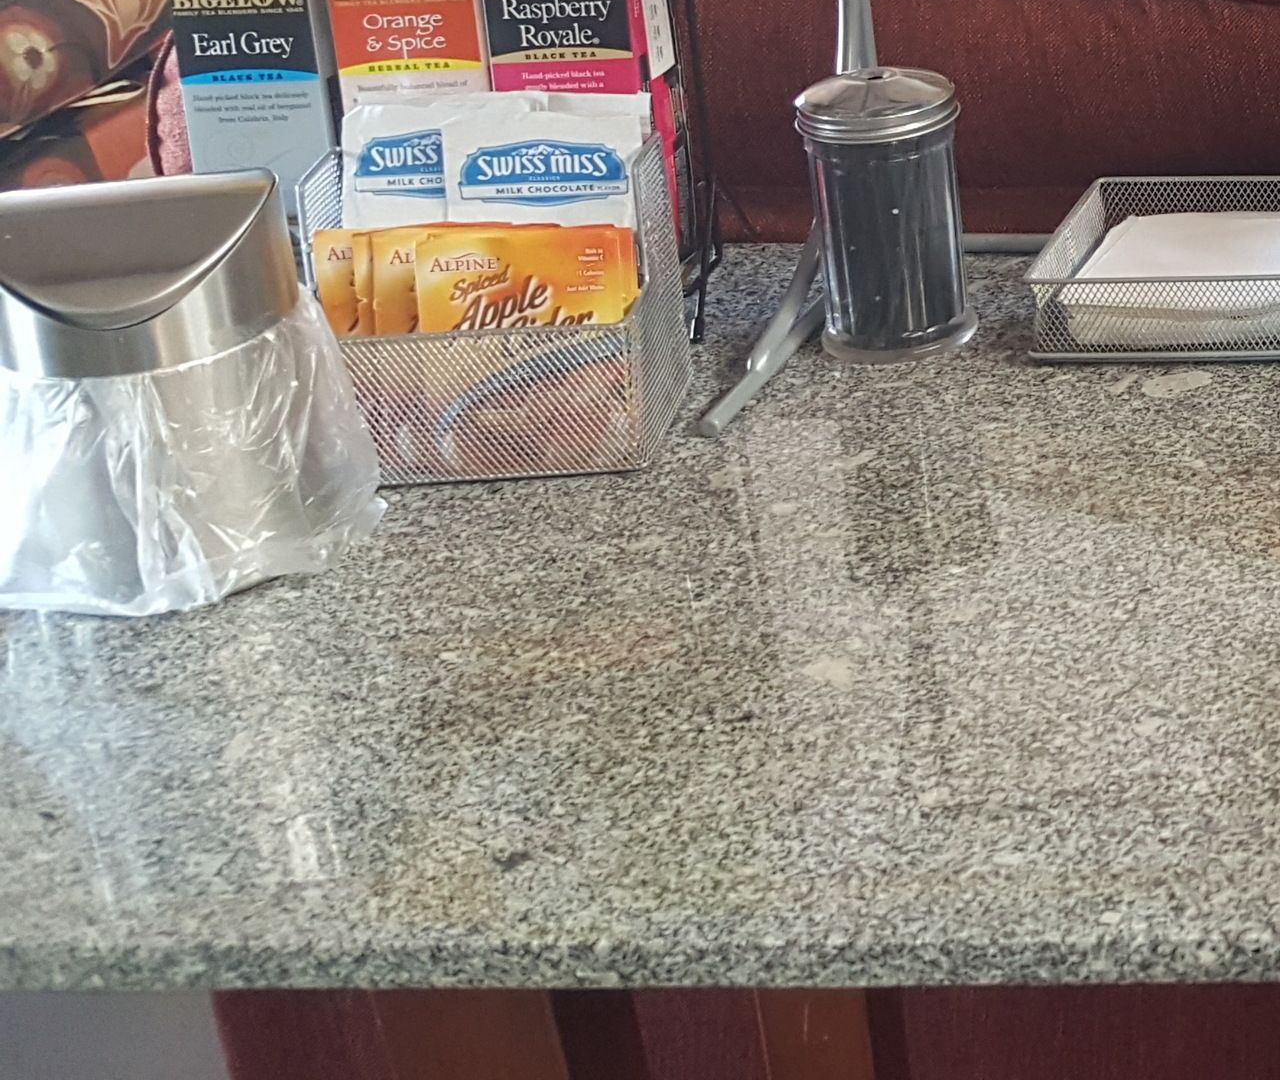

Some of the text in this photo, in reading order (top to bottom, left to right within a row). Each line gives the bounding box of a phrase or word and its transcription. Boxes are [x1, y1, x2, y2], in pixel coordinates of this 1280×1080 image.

[363, 14, 444, 35] Orange
[518, 23, 592, 47] Royale
[192, 31, 294, 59] Earl Grey
[366, 35, 446, 60] & Spice
[525, 52, 566, 60] BLACK
[369, 63, 420, 72] HERBAL
[522, 72, 569, 80] Hand-picked
[212, 74, 253, 82] BLACK
[549, 82, 578, 90] blended
[369, 144, 438, 172] SWISS
[477, 152, 607, 181] SWISS MISS
[386, 178, 416, 187] MILK
[495, 183, 595, 195] MILK CHOCOLATE
[430, 257, 497, 273] ALPINE
[449, 264, 511, 302] Spiced
[453, 273, 550, 330] Apple
